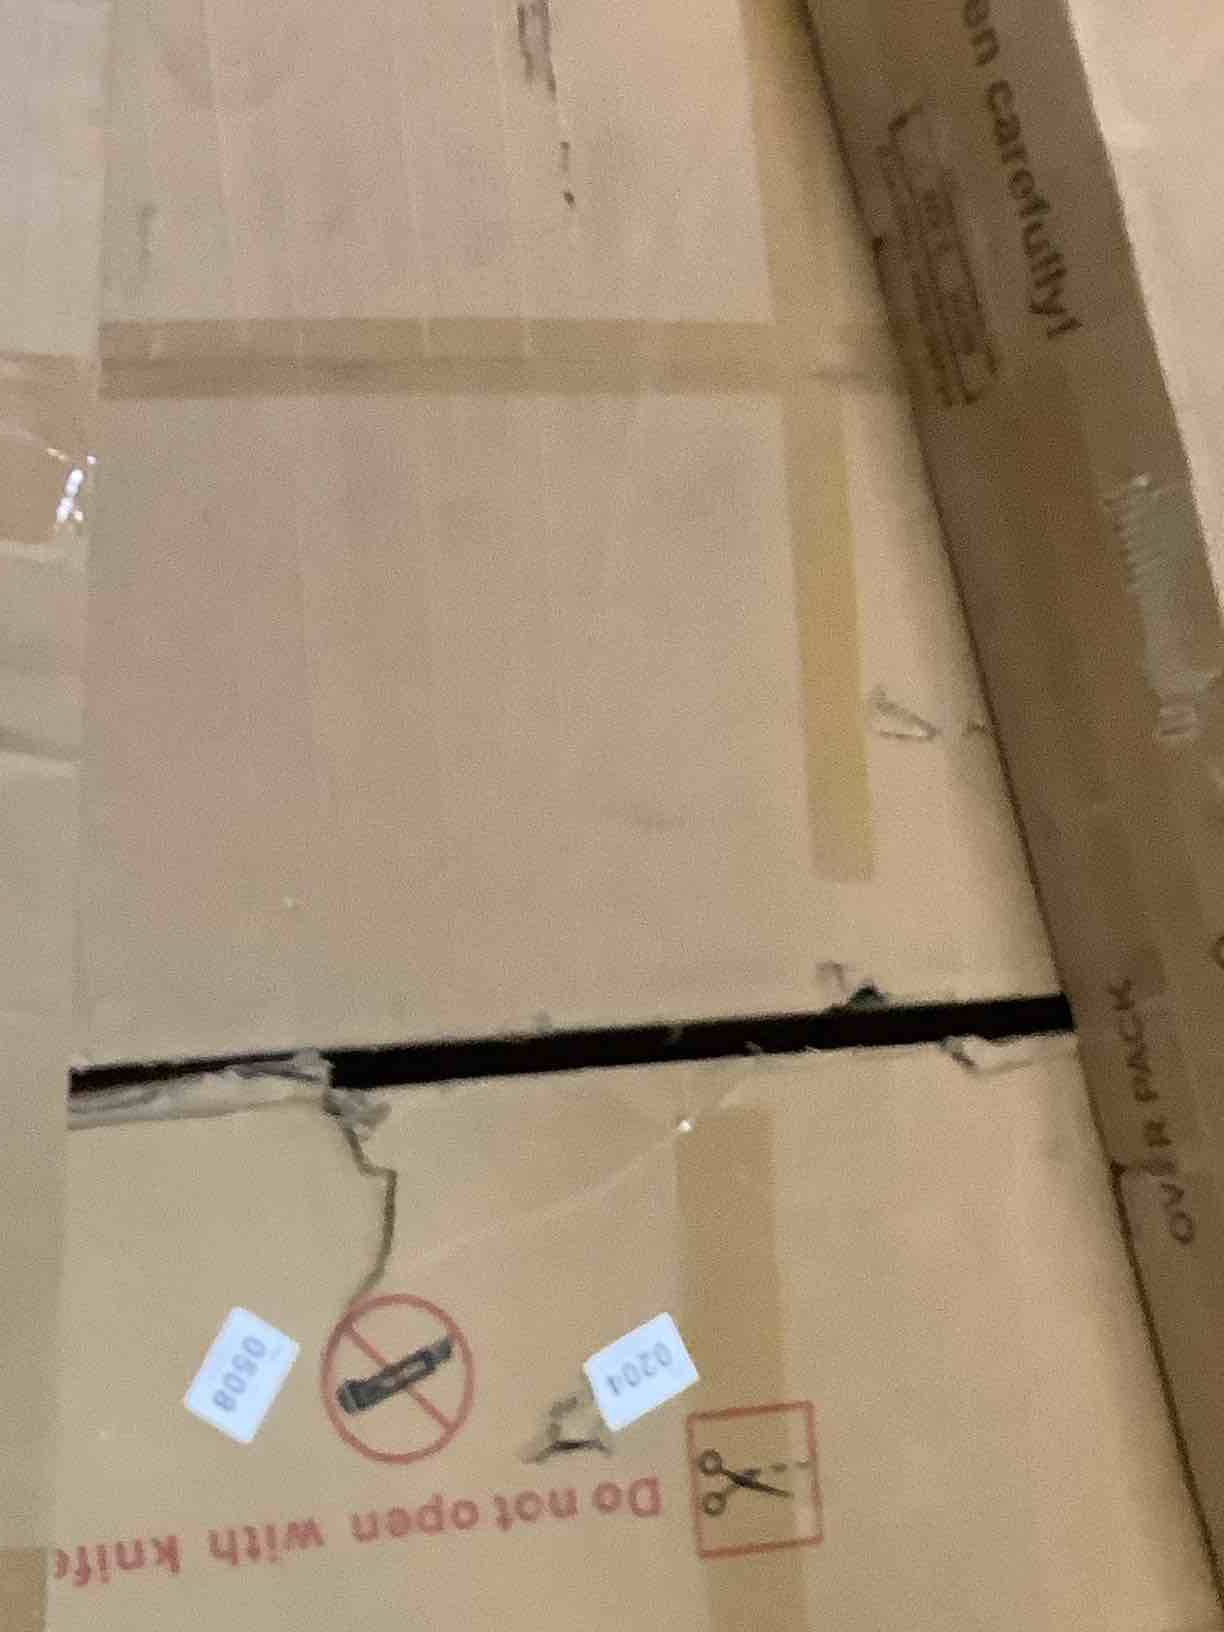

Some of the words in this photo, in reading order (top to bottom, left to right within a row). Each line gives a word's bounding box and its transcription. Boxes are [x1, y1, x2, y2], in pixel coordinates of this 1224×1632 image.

[350, 1492, 479, 1542] open
[492, 1487, 577, 1532] not
[589, 1476, 663, 1518] Do
[207, 1516, 324, 1566] with
